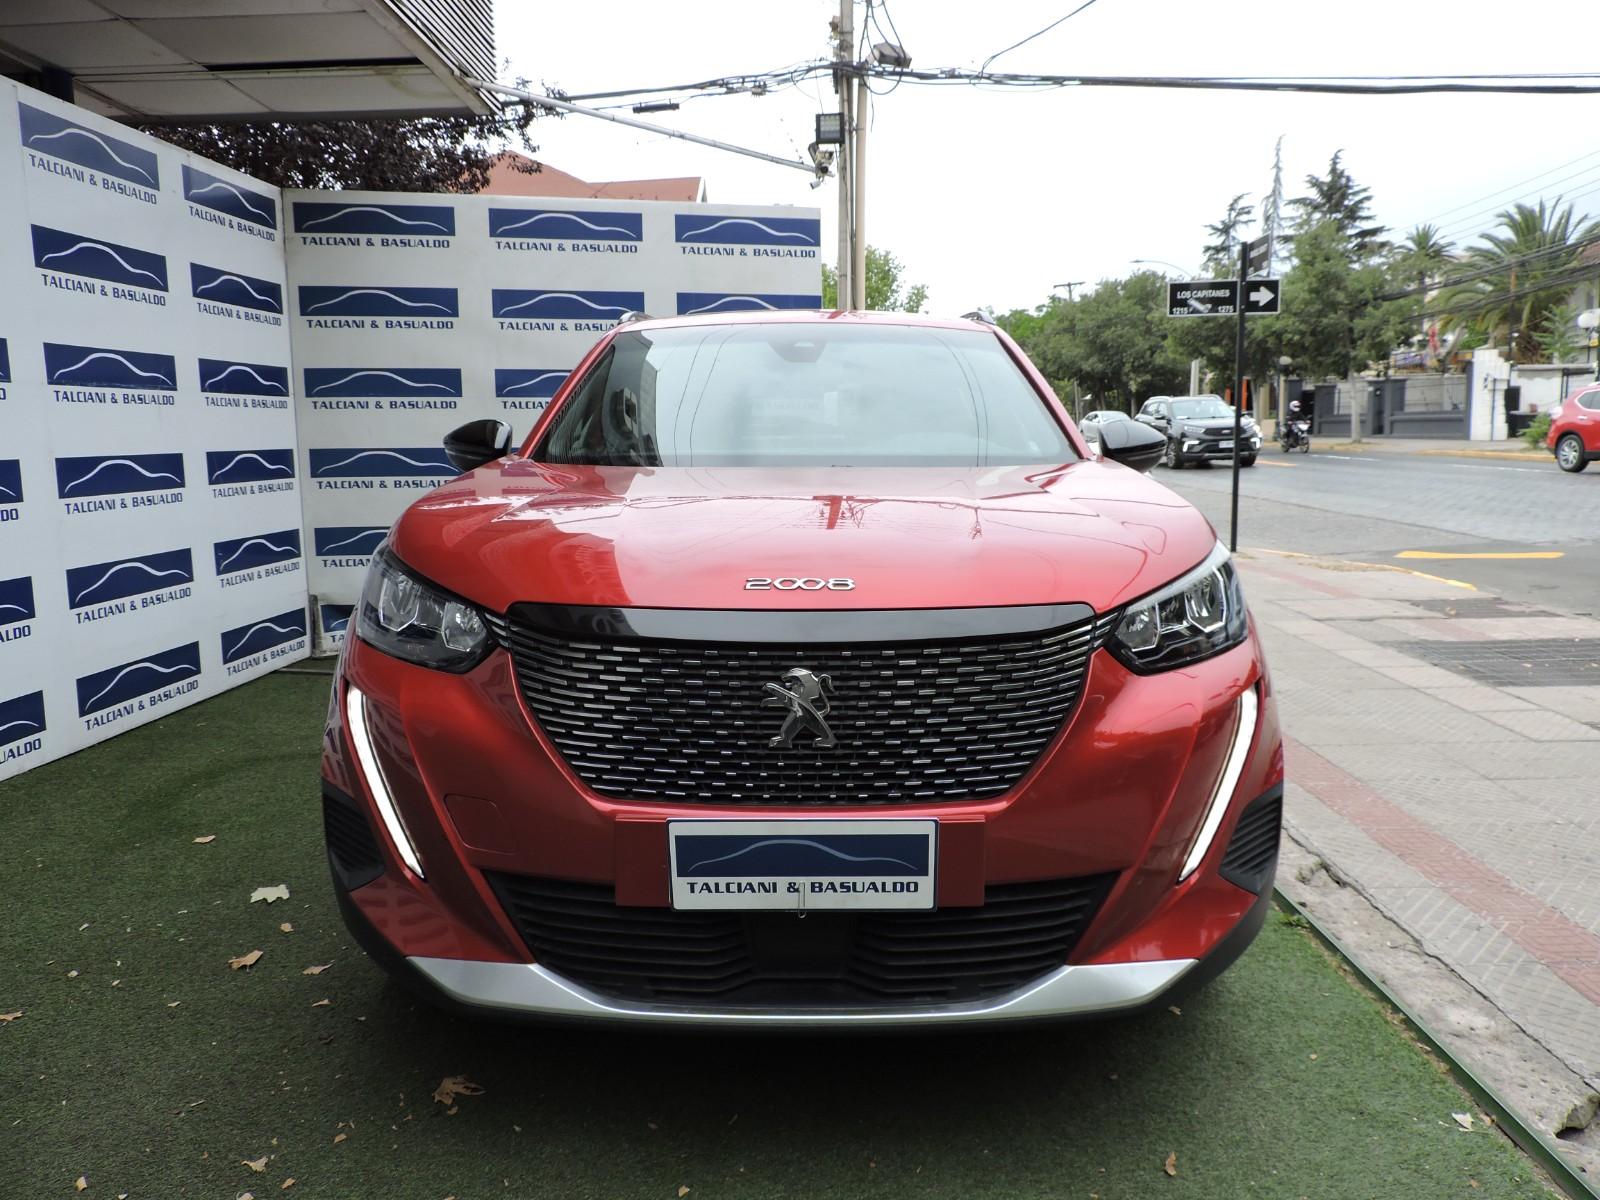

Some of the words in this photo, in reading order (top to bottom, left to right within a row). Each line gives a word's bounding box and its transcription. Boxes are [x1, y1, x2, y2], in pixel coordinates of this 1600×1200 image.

[29, 154, 84, 182] TALCIANI
[90, 174, 97, 186] &
[102, 178, 157, 205] BASUALDO
[188, 205, 226, 227] TALCIANI
[228, 219, 234, 229] &
[237, 222, 275, 242] BASUALDO
[301, 236, 360, 246] TALCIANI
[366, 238, 375, 246] &
[381, 238, 450, 248] BASUALDO
[496, 241, 552, 251] TALCIANI
[558, 243, 566, 251] &
[572, 244, 637, 253] BASUALDO
[681, 246, 734, 256] TALCIANI
[754, 249, 815, 258] BASUALDO
[41, 274, 95, 294] TALCIANI
[100, 285, 108, 296] &
[112, 287, 166, 306] BASUALDO
[1176, 291, 1191, 299] LOS
[1192, 289, 1230, 298] CAPITANES
[197, 302, 233, 318] TALCIANI
[236, 310, 242, 319] &
[244, 311, 281, 326] BASUALDO
[306, 320, 365, 328] TALCIANI
[370, 320, 379, 328] &
[385, 320, 453, 329] BASUALDO
[499, 322, 554, 331] TALCIANI
[54, 390, 106, 403] TALCIANI
[111, 393, 118, 404] &
[123, 394, 174, 405] BASUALDO
[205, 397, 240, 407] TALCIANI
[243, 399, 249, 408] &
[251, 399, 288, 409] BASUALDO
[312, 401, 369, 410] TALCIANI
[375, 401, 383, 409] &
[390, 401, 457, 409] BASUALDO
[212, 486, 247, 498] TALCIANI
[250, 485, 255, 494] &
[258, 482, 293, 494] BASUALDO
[317, 480, 373, 489] TALCIANI
[64, 499, 116, 514] TALCIANI
[120, 498, 128, 508] &
[132, 493, 183, 507] BASUALDO
[220, 572, 254, 588] TALCIANI
[257, 570, 262, 579] &
[265, 562, 300, 577] BASUALDO
[744, 577, 856, 590] 2008
[75, 603, 125, 624] TALCIANI
[130, 600, 137, 611] &
[142, 587, 191, 608] BASUALDO
[227, 656, 260, 676] TALCIANI
[263, 654, 268, 663] &
[270, 640, 305, 659] BASUALDO
[85, 704, 134, 731] TALCIANI
[138, 700, 145, 711] &
[150, 680, 198, 706] BASUALDO
[686, 882, 778, 894] TALCIANI
[786, 882, 800, 894] &
[810, 881, 918, 893] BASUALDO
